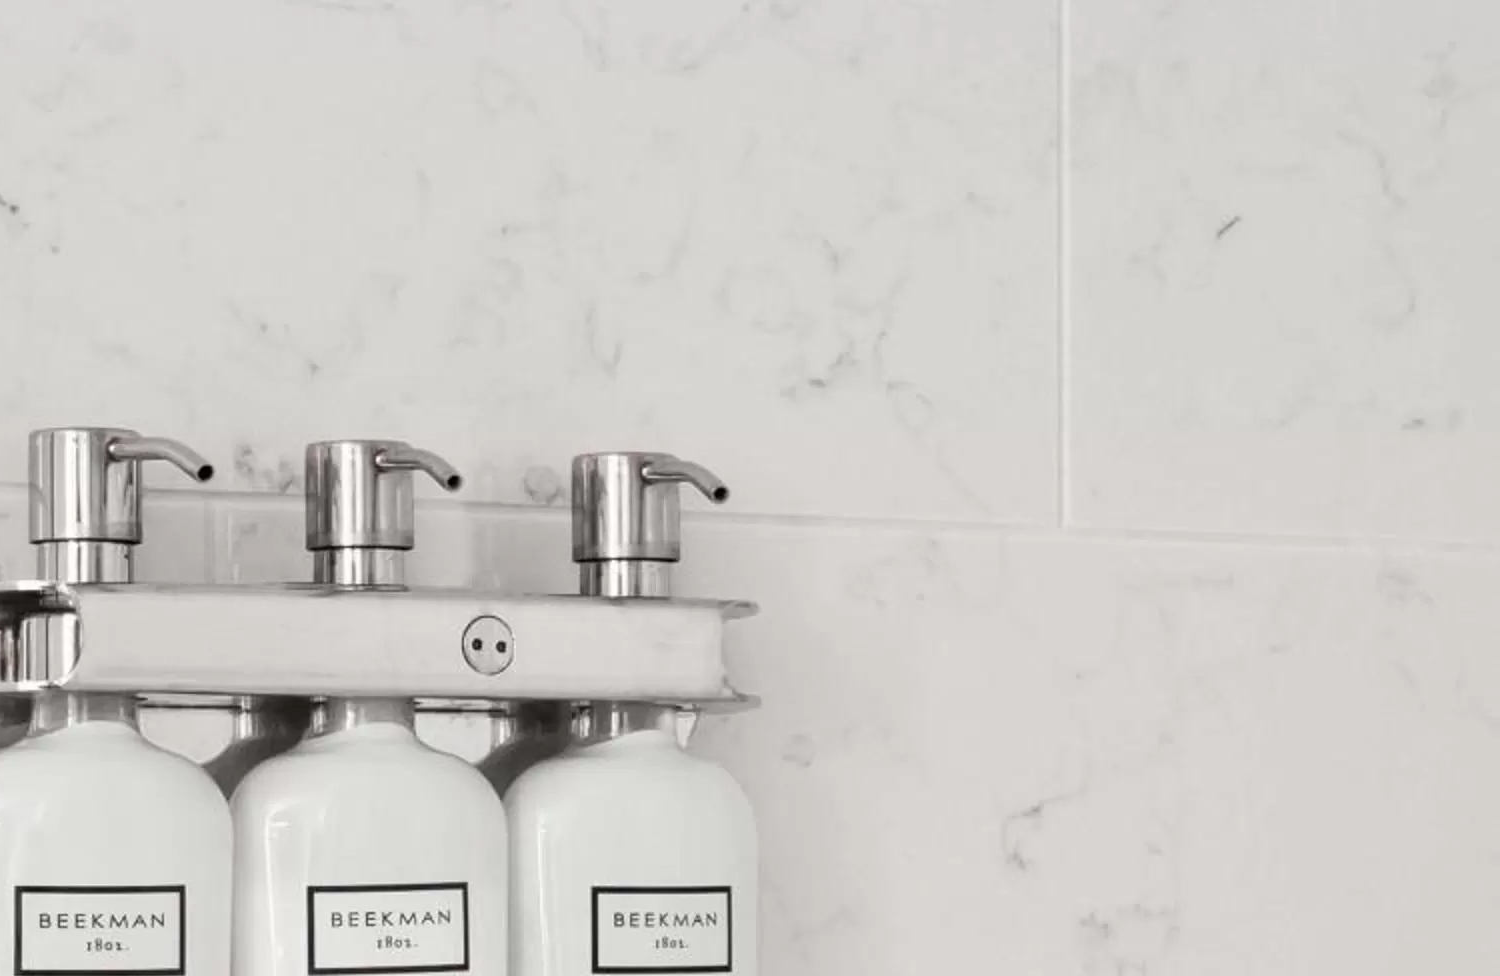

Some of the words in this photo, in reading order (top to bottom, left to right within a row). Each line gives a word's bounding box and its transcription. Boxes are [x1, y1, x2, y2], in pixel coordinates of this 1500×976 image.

[38, 912, 165, 929] BEEKMAN
[330, 909, 451, 928] BEEKMAN
[612, 911, 718, 928] BEEKMAN
